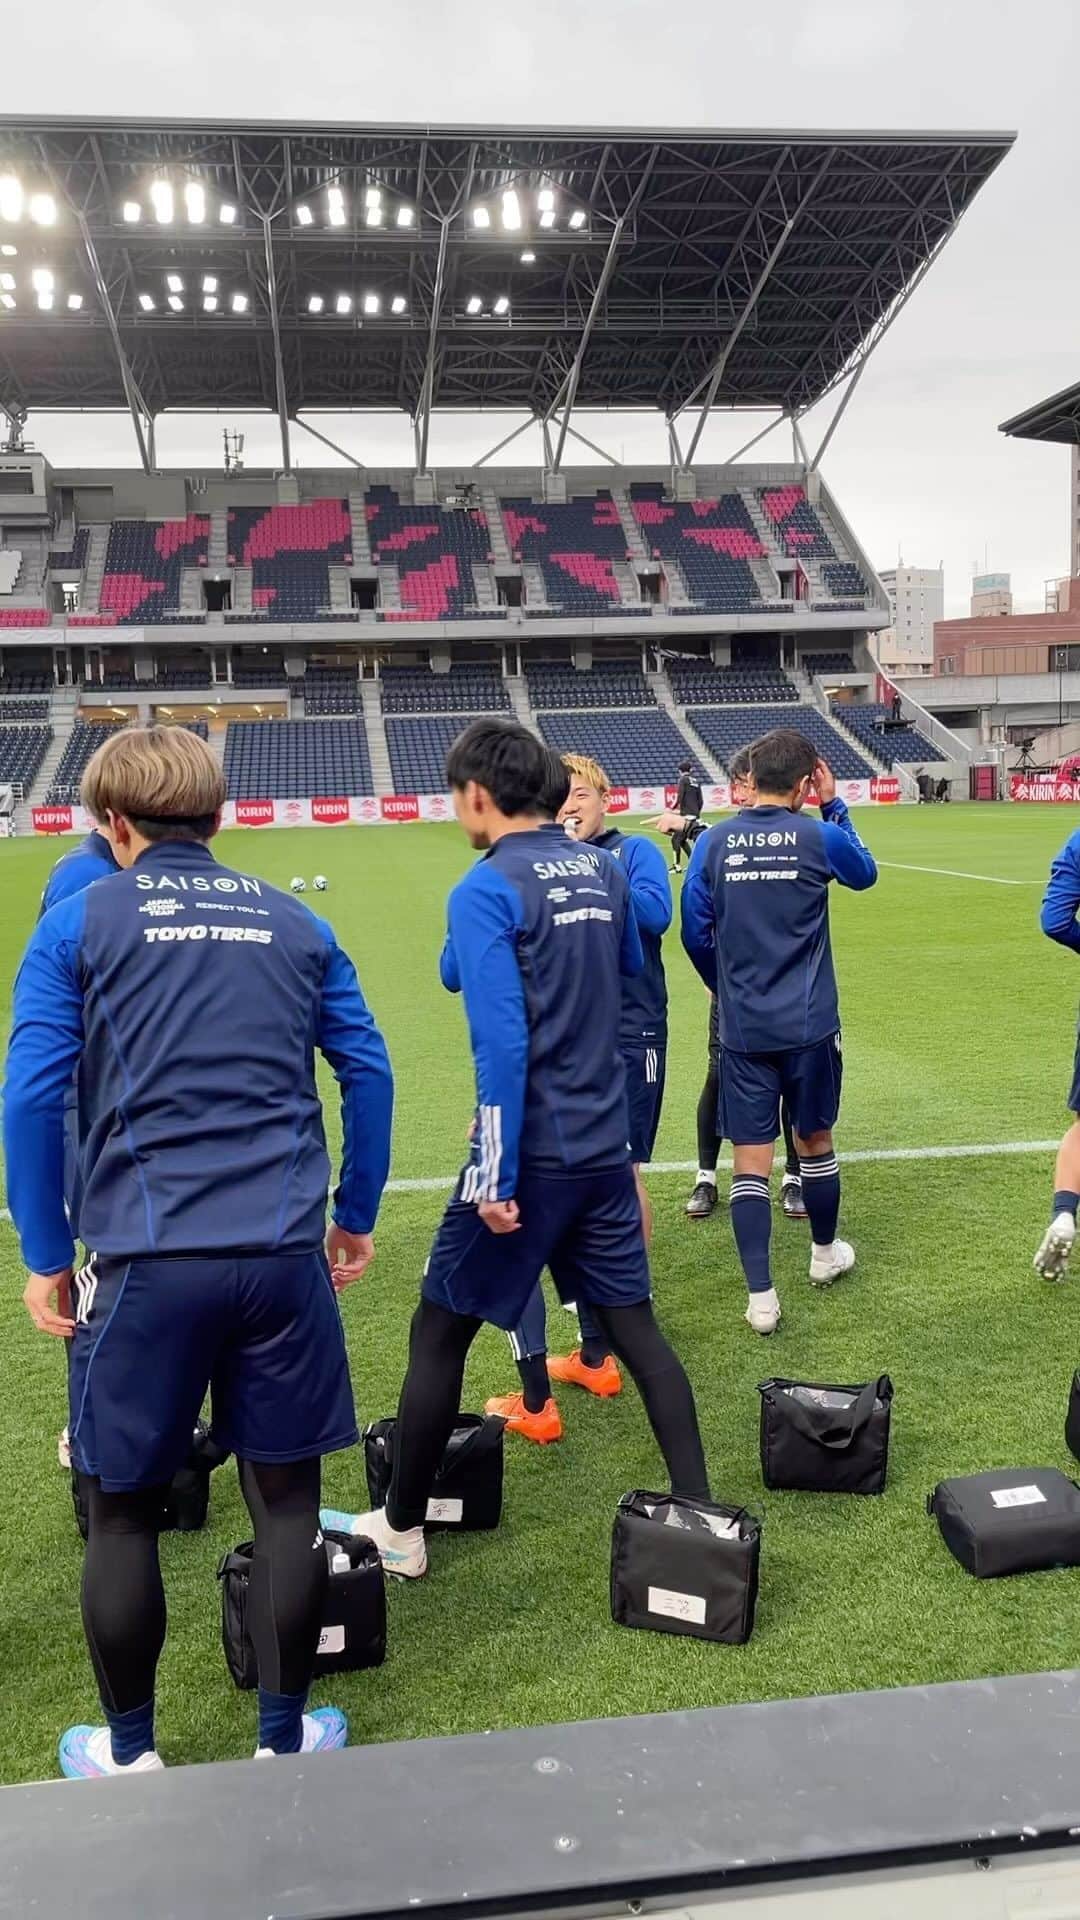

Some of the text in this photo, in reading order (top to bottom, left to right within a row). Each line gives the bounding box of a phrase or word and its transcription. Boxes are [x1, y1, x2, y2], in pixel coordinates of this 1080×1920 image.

[1029, 783, 1056, 800] KIRIN
[609, 794, 627, 806] RIN
[237, 806, 272, 817] KIRIN
[313, 804, 347, 815] KIRIN
[383, 802, 417, 813] KIRIN
[34, 813, 70, 825] KIRIN
[726, 831, 797, 848] SAISON
[725, 870, 799, 882] TOYO TIRES
[136, 875, 262, 897] SAISON
[148, 909, 176, 917] TEAM
[144, 925, 272, 944] TOYO TIRES
